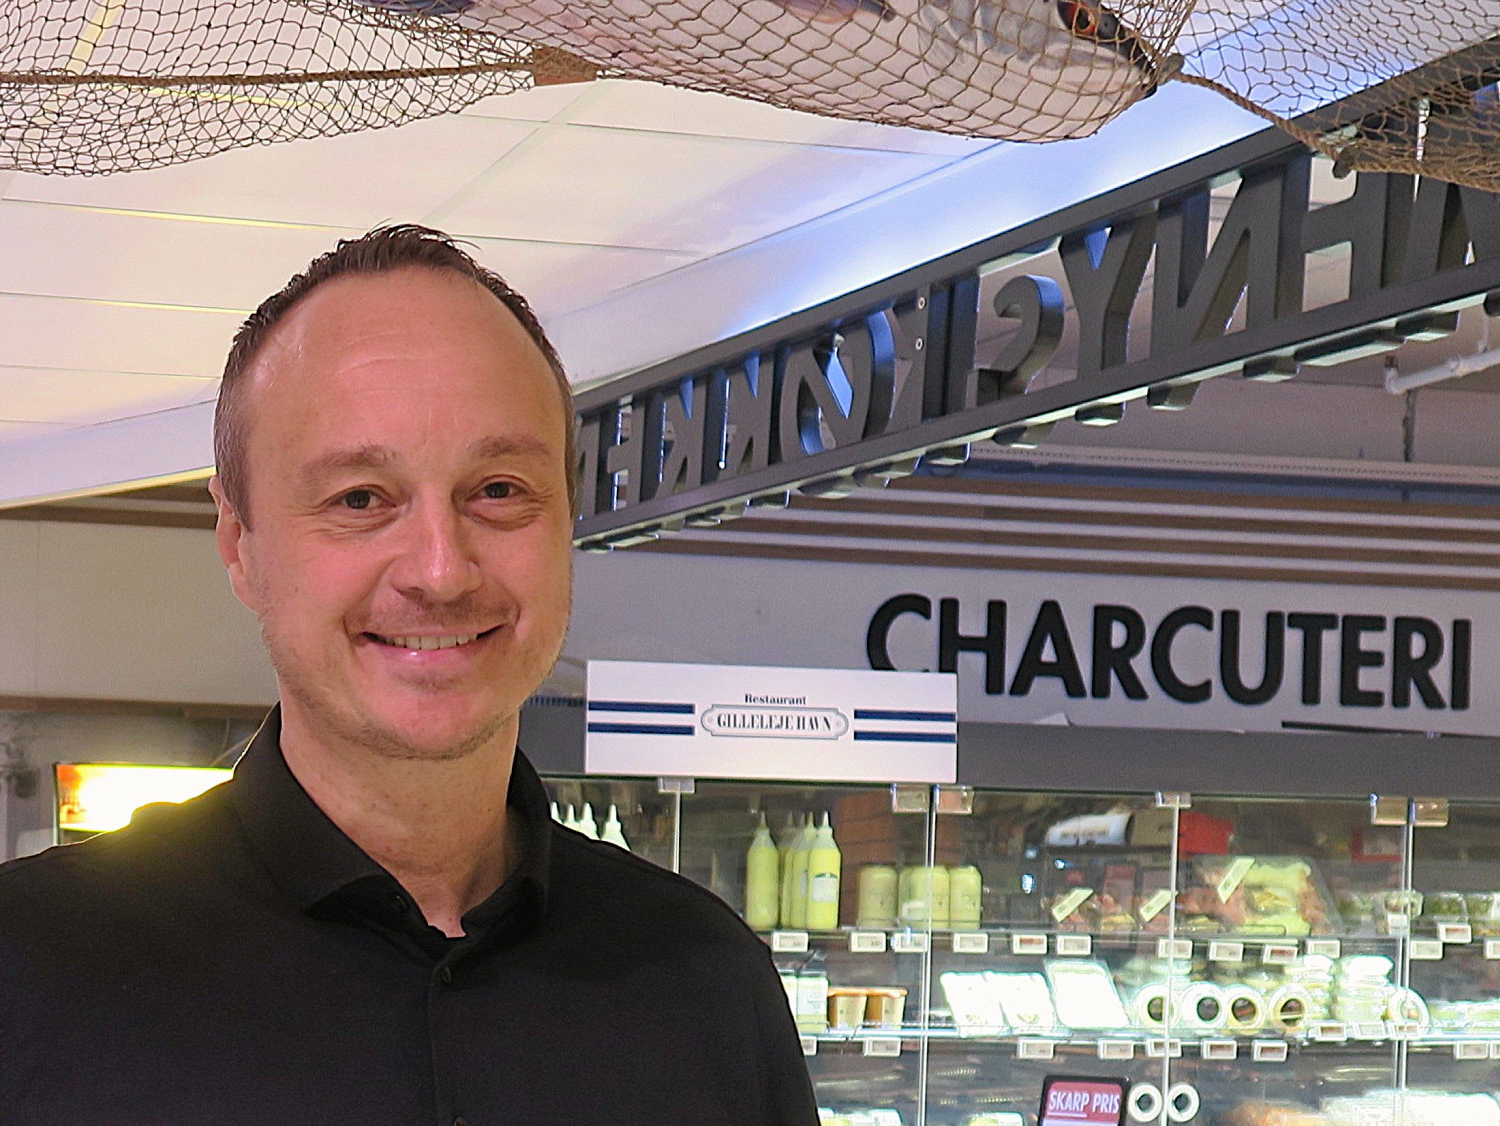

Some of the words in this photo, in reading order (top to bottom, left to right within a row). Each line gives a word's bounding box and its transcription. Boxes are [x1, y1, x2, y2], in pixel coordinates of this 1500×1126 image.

[866, 593, 1472, 711] CHARCUTERI
[744, 693, 807, 706] Restaurant
[717, 713, 794, 731] GILLELEJE
[796, 715, 833, 732] HAVN
[1049, 1090, 1091, 1113] SKARP
[1091, 1092, 1120, 1114] PRIS
